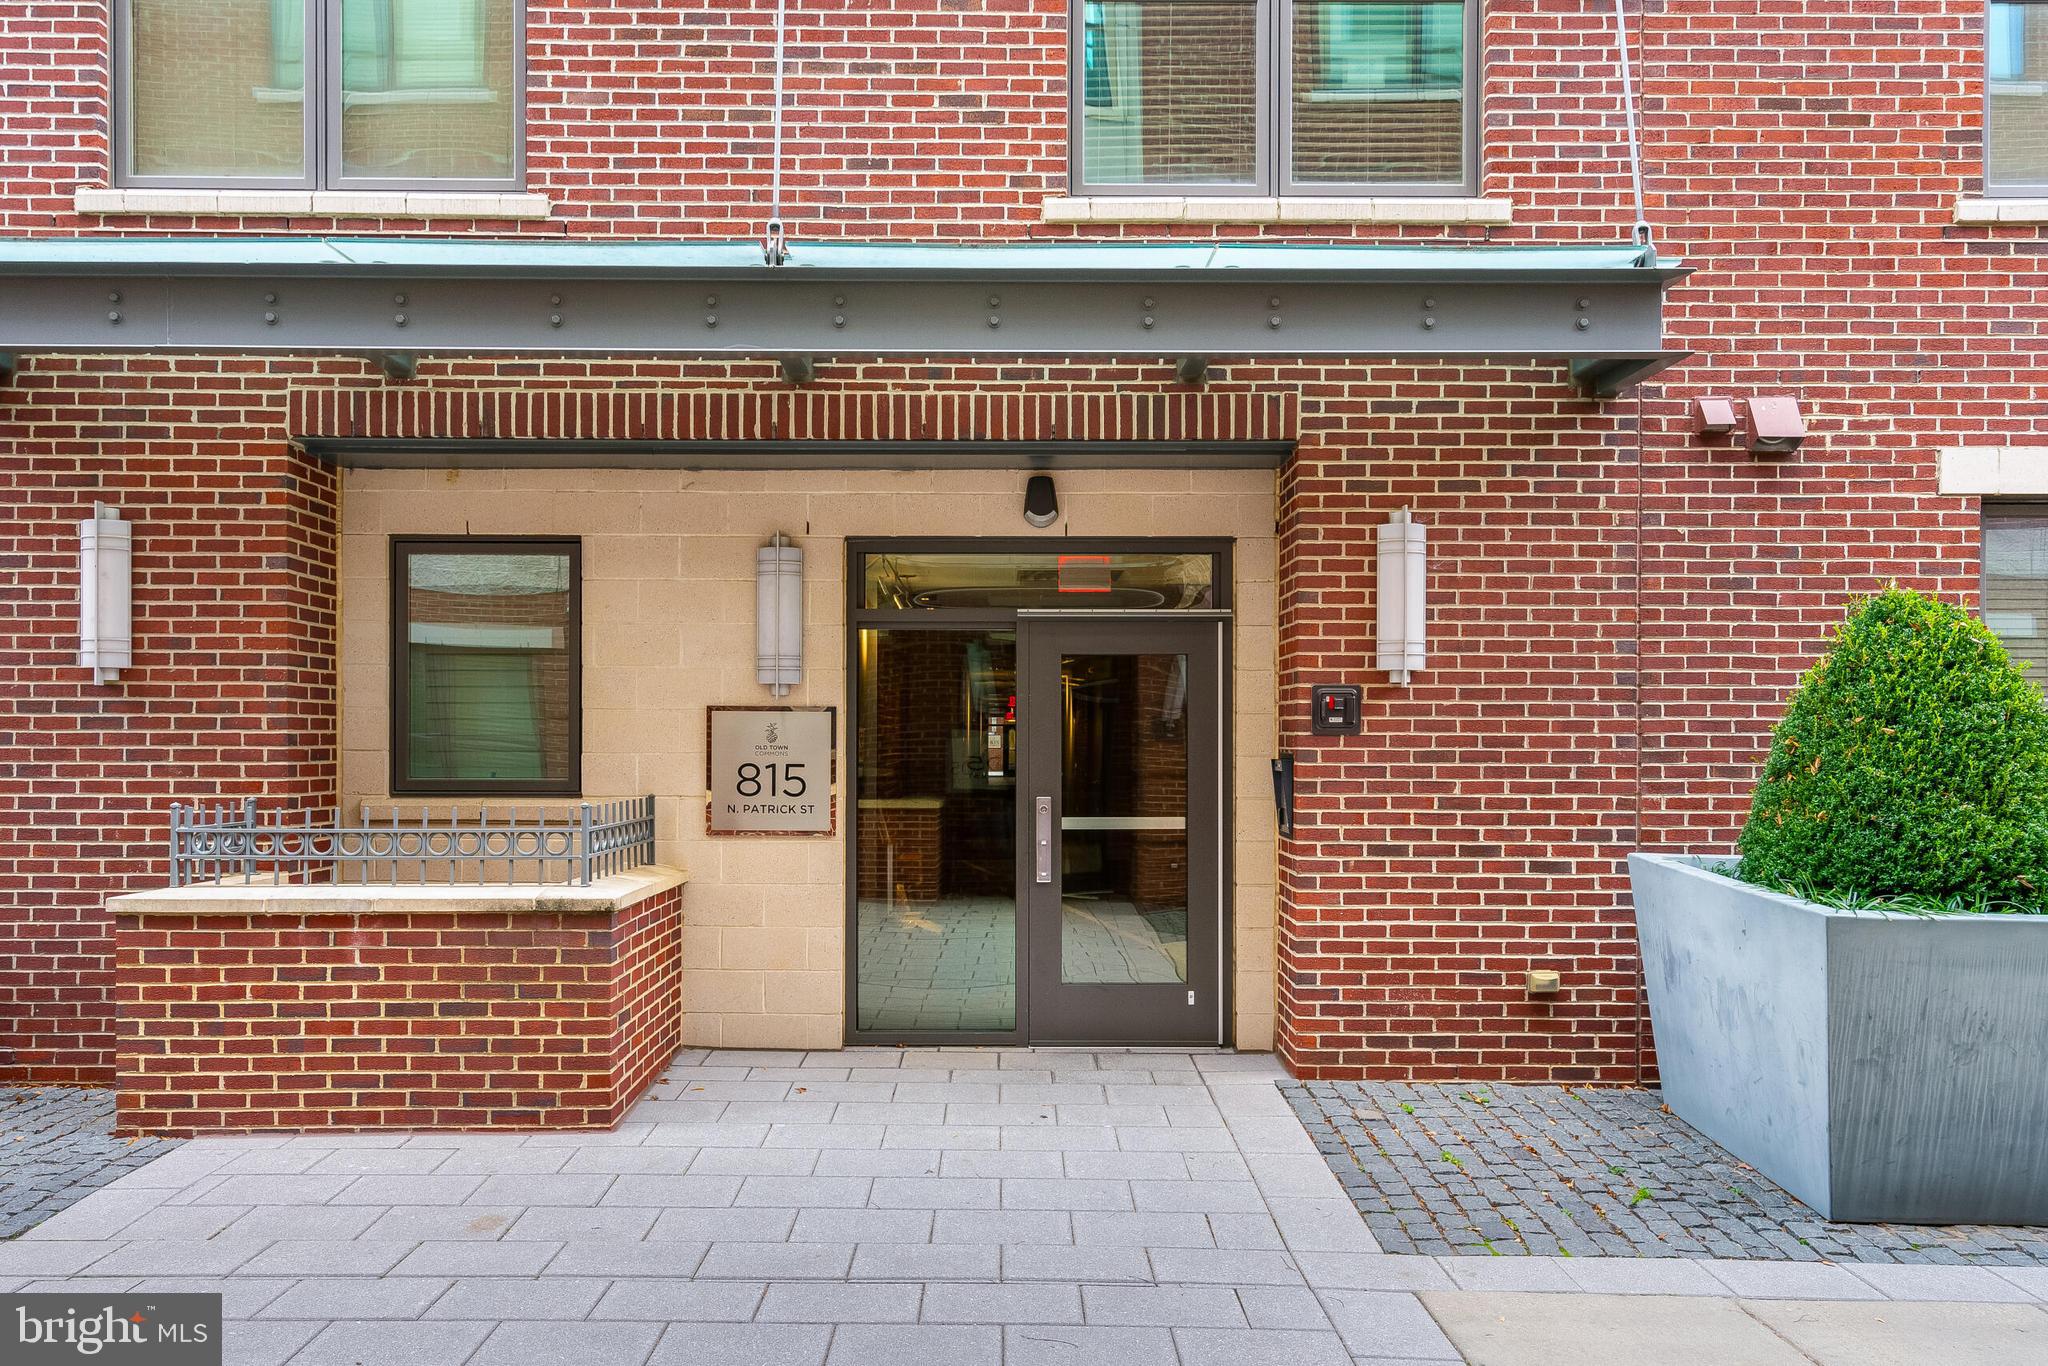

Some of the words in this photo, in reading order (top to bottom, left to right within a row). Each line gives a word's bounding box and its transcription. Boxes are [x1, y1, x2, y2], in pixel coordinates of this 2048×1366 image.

[736, 762, 807, 798] 815
[727, 804, 740, 814] N.
[743, 804, 797, 814] PATRICK
[800, 804, 815, 814] ST
